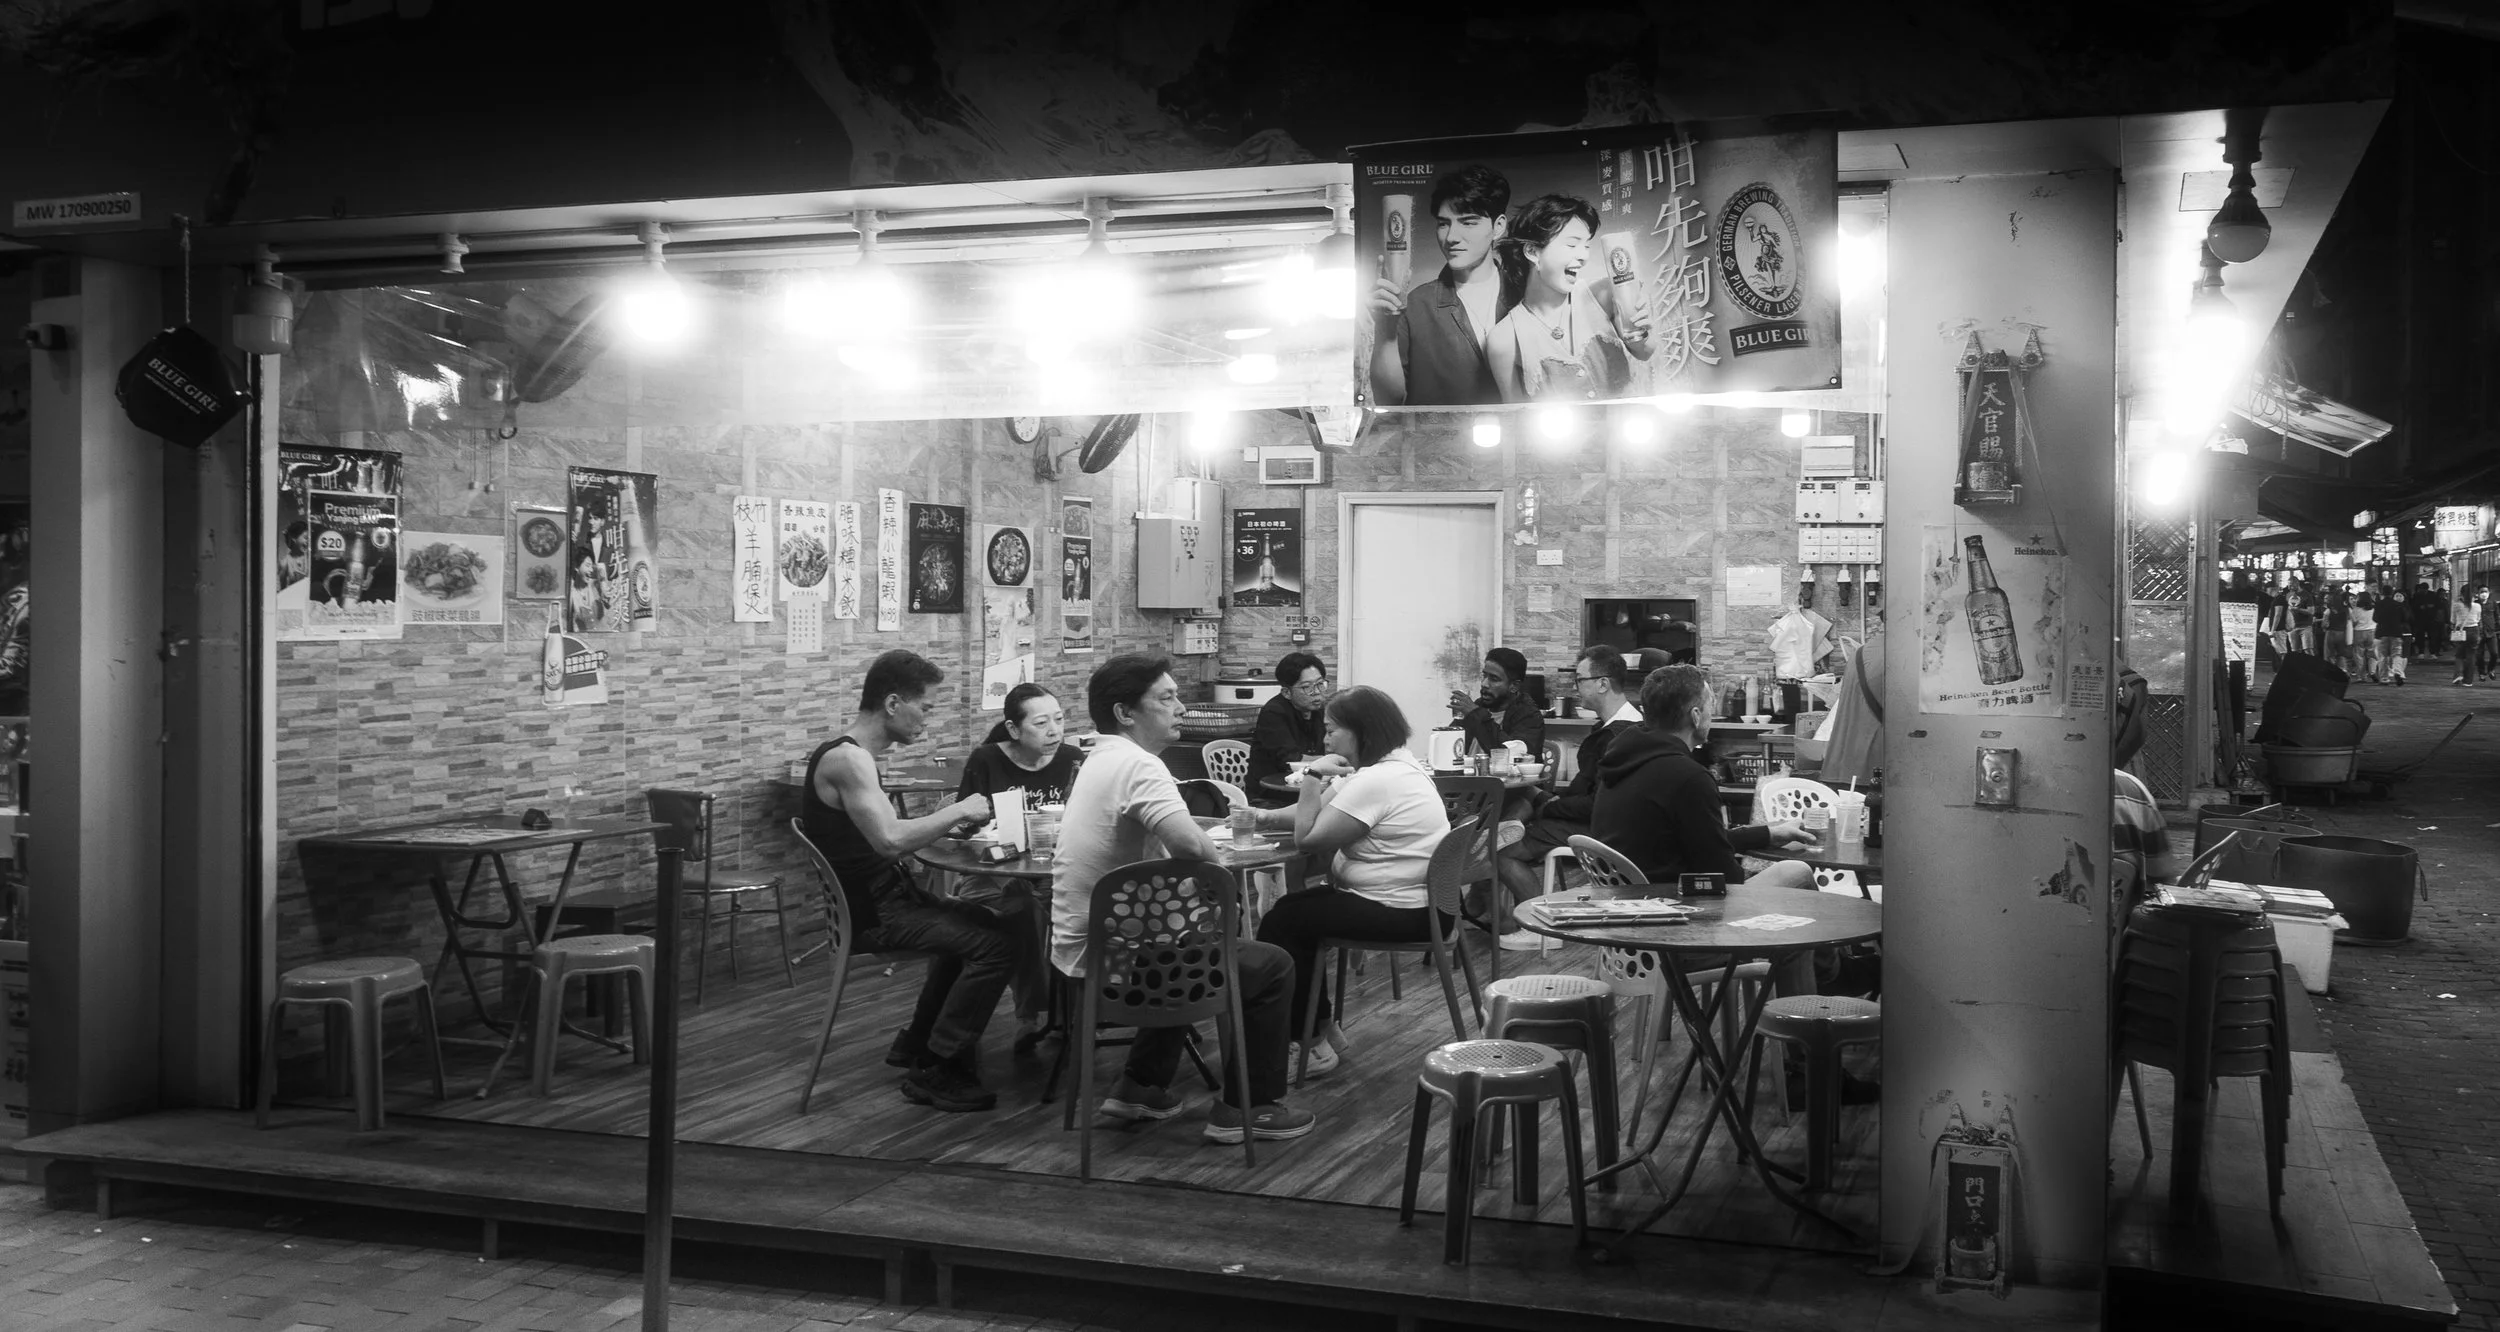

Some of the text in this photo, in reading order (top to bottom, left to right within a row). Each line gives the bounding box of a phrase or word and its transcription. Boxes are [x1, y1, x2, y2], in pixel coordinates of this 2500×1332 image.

[1366, 164, 1433, 175] BLUE GIRL
[26, 199, 132, 220] MW 170900250
[1722, 191, 1801, 251] GERMAN BREWING TRADITION
[1644, 131, 1721, 383] 咁先夠爽
[1729, 274, 1771, 313] PILSENER
[1776, 291, 1801, 314] LAGER
[1735, 329, 1782, 349] BLUE
[148, 358, 186, 387] BLUE
[184, 384, 217, 412] GIRL
[281, 451, 321, 461] BLUE GIRL
[324, 502, 381, 515] Premium
[320, 537, 343, 549] $20
[2014, 547, 2058, 556] Heineken
[605, 524, 631, 630] 咁先夠爽
[1940, 684, 2051, 701] Heineken Beer Bottle
[1049, 785, 1063, 800] is
